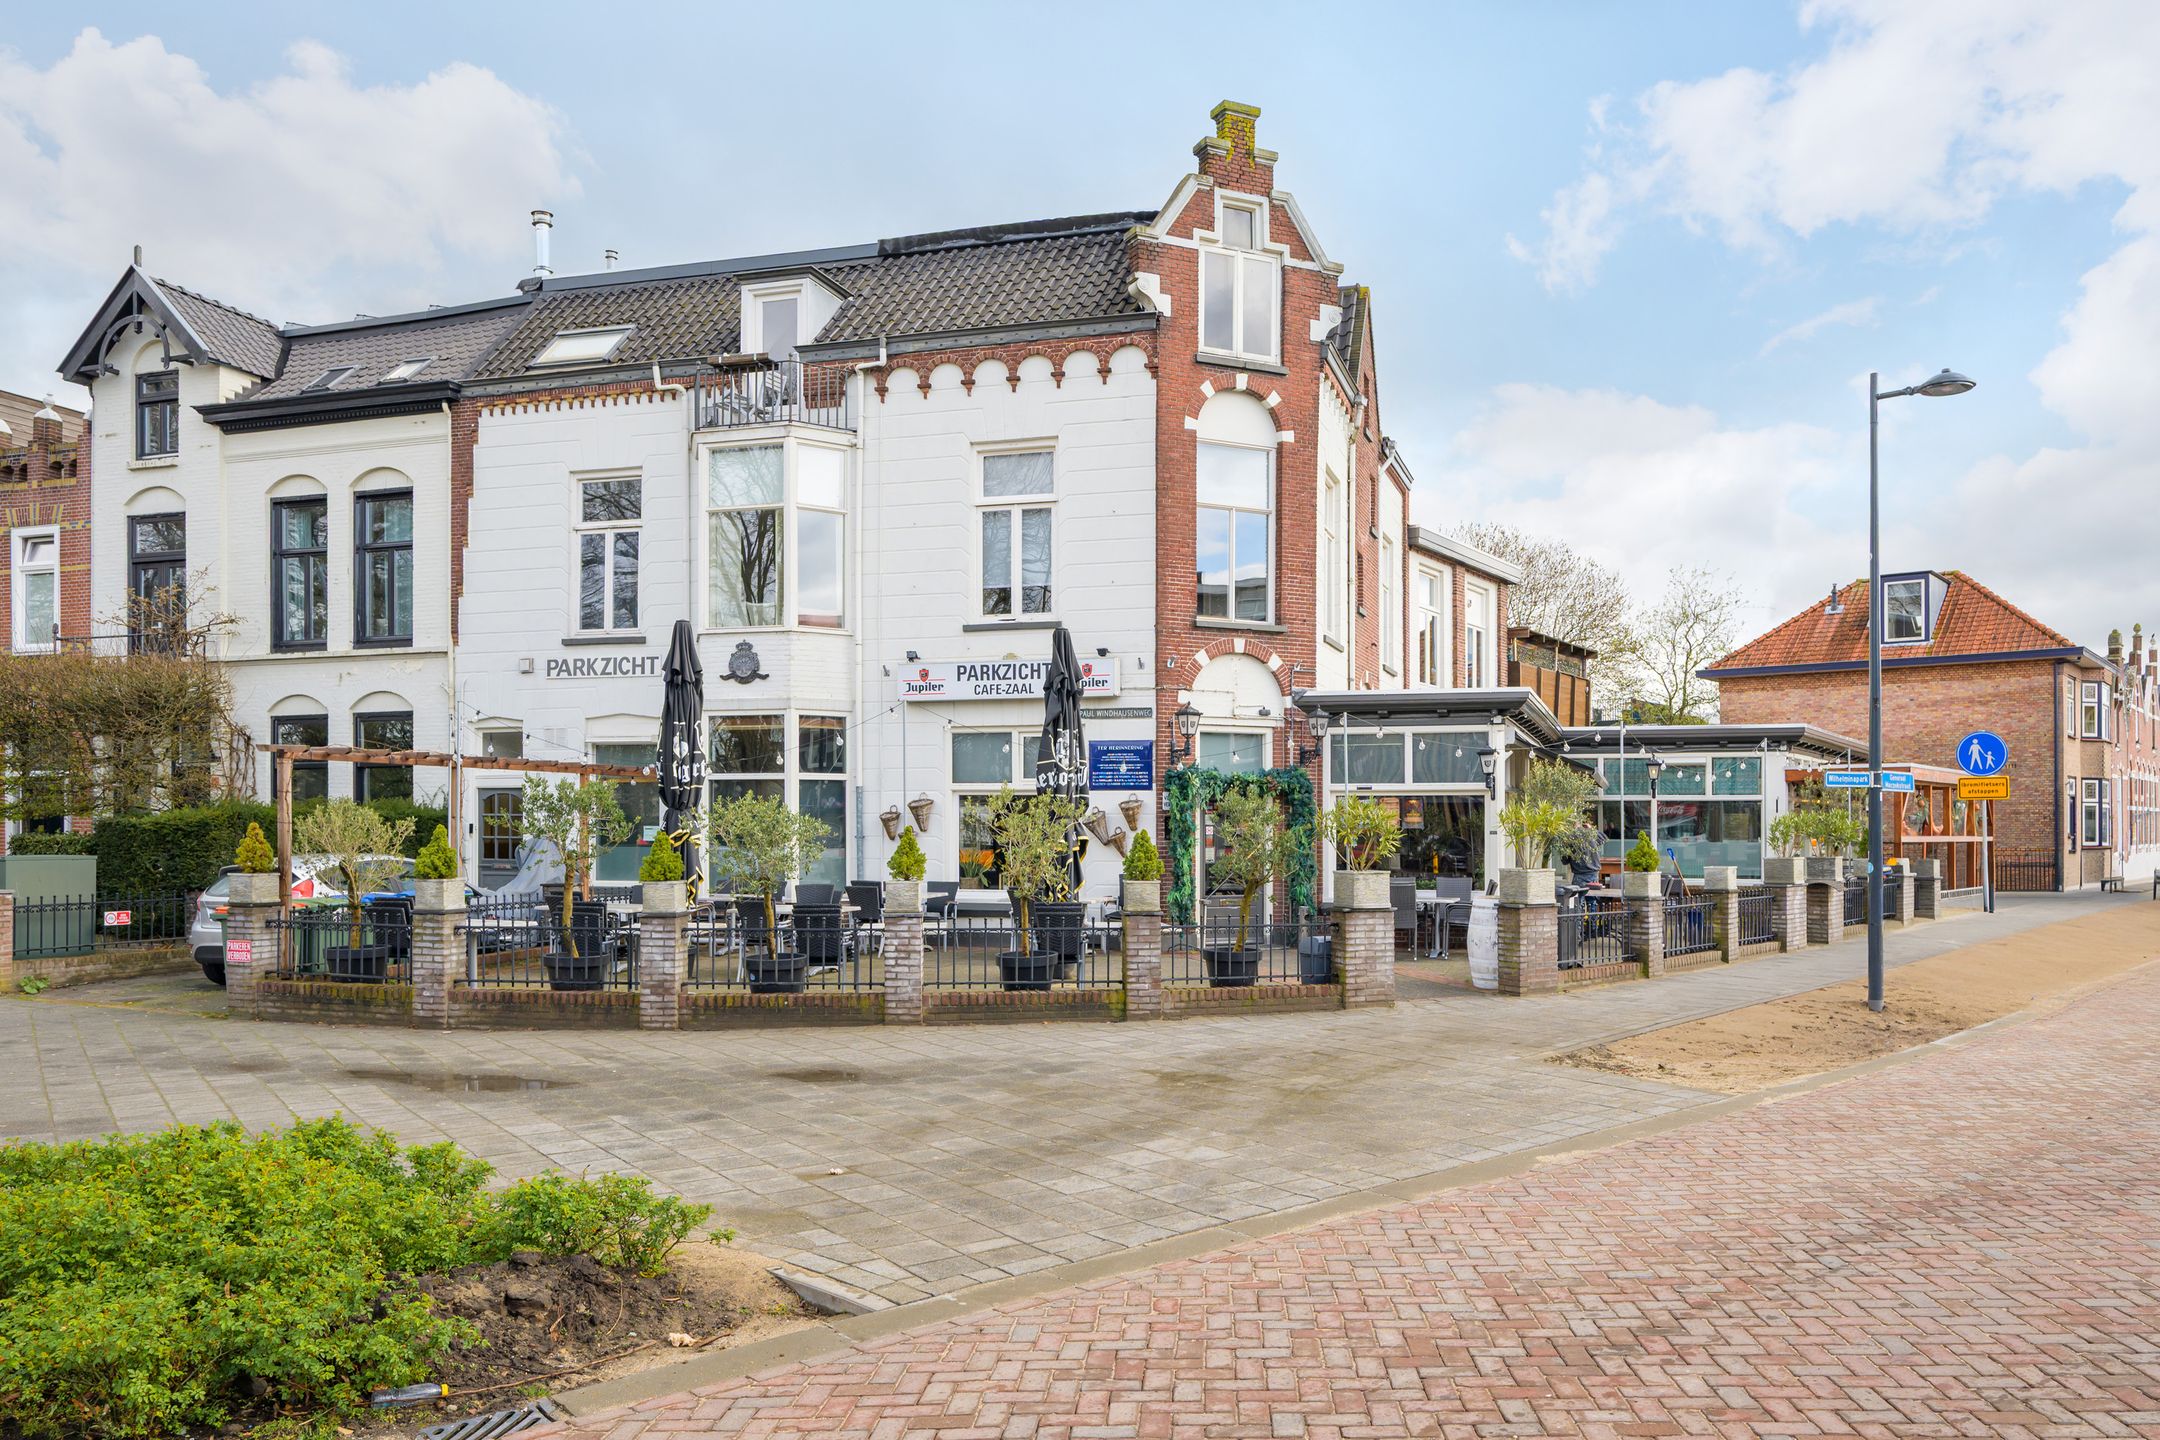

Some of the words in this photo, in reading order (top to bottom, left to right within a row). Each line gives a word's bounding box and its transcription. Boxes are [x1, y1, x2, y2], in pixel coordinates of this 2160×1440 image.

[546, 656, 659, 677] PARKZICHT
[956, 662, 1050, 682] PARKZICHT
[905, 682, 944, 695] Jupiler
[1081, 678, 1108, 689] piler
[974, 683, 1035, 696] CAFE-ZAAL
[1096, 709, 1152, 717] WINDHAUSENWEG
[1828, 774, 1869, 785] Wilhelminapark
[227, 941, 251, 951] PARKEREN
[227, 951, 251, 961] VERBODEN
